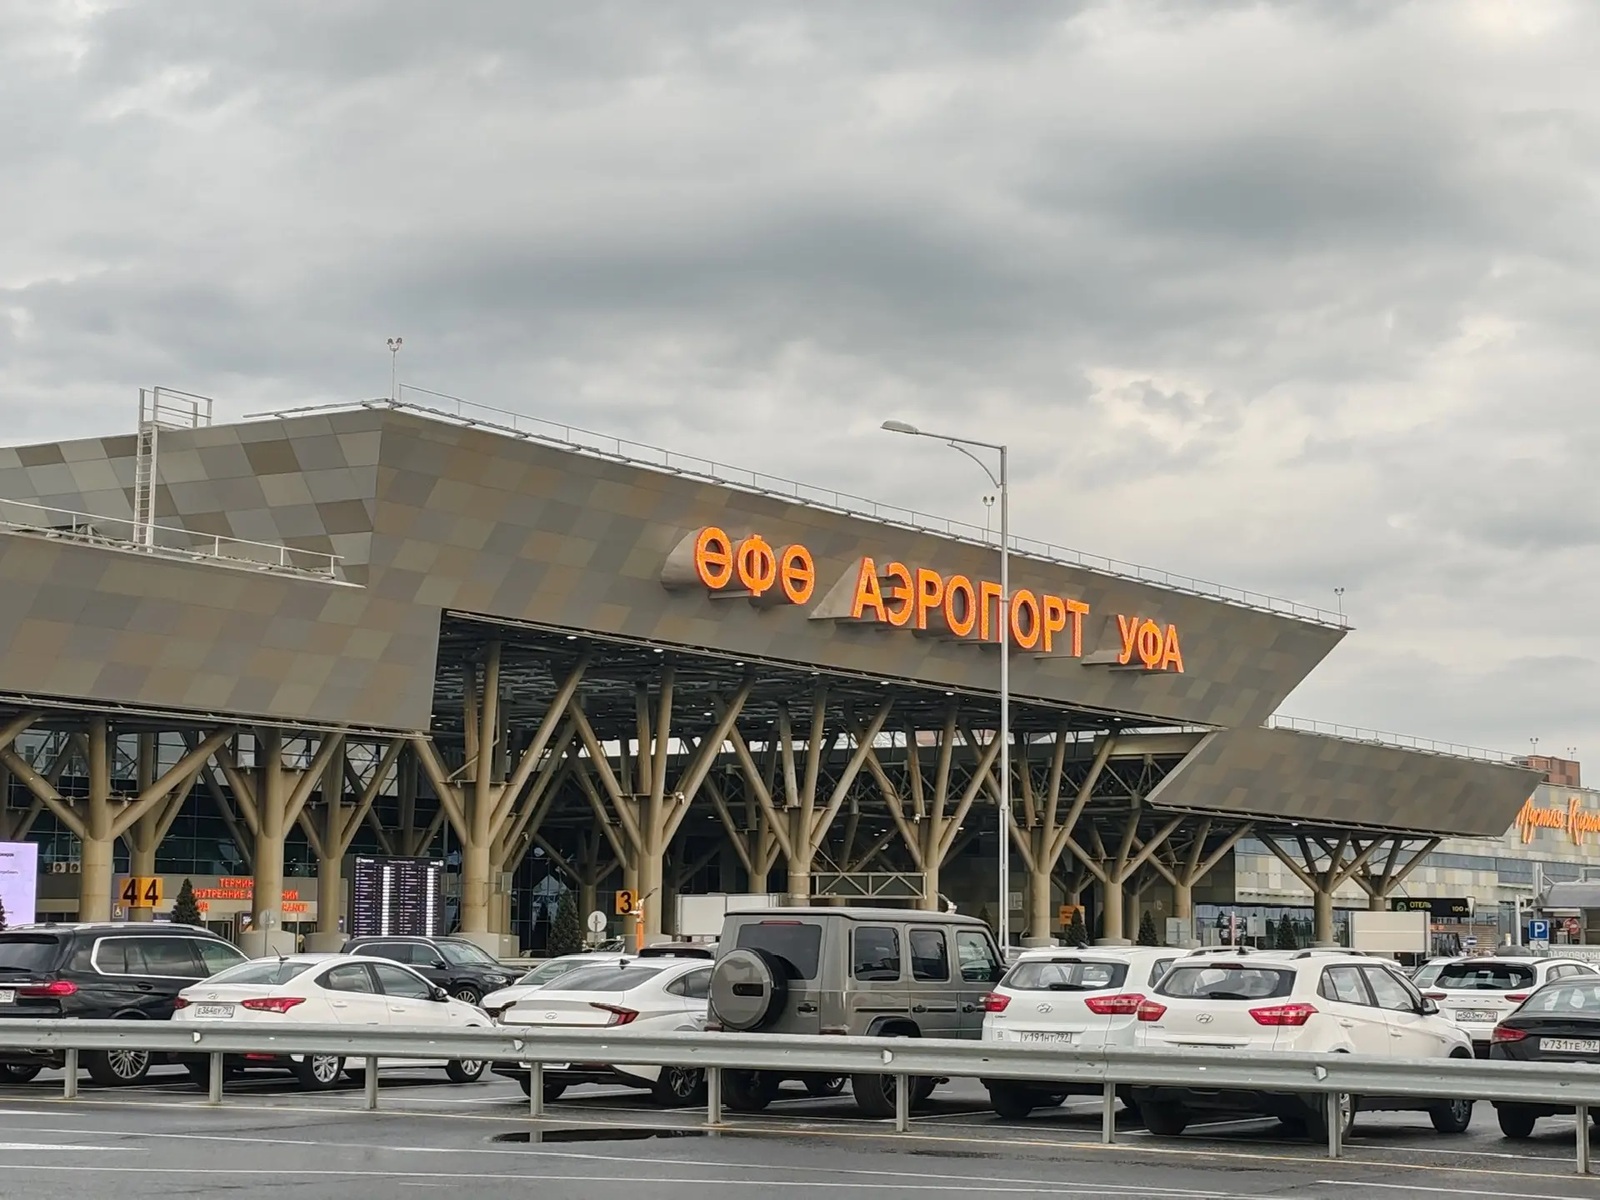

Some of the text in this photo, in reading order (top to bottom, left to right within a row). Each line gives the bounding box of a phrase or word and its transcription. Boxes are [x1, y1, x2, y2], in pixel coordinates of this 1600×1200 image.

[852, 557, 1090, 657] АЭРОПОРТ
[1117, 614, 1185, 673] УФА
[123, 878, 138, 906] 4
[144, 878, 159, 906] 4
[191, 889, 244, 899] НУТРЕННИЕ
[219, 878, 254, 888] ТЕРМИН
[620, 891, 631, 913] 3
[1534, 922, 1546, 937] P
